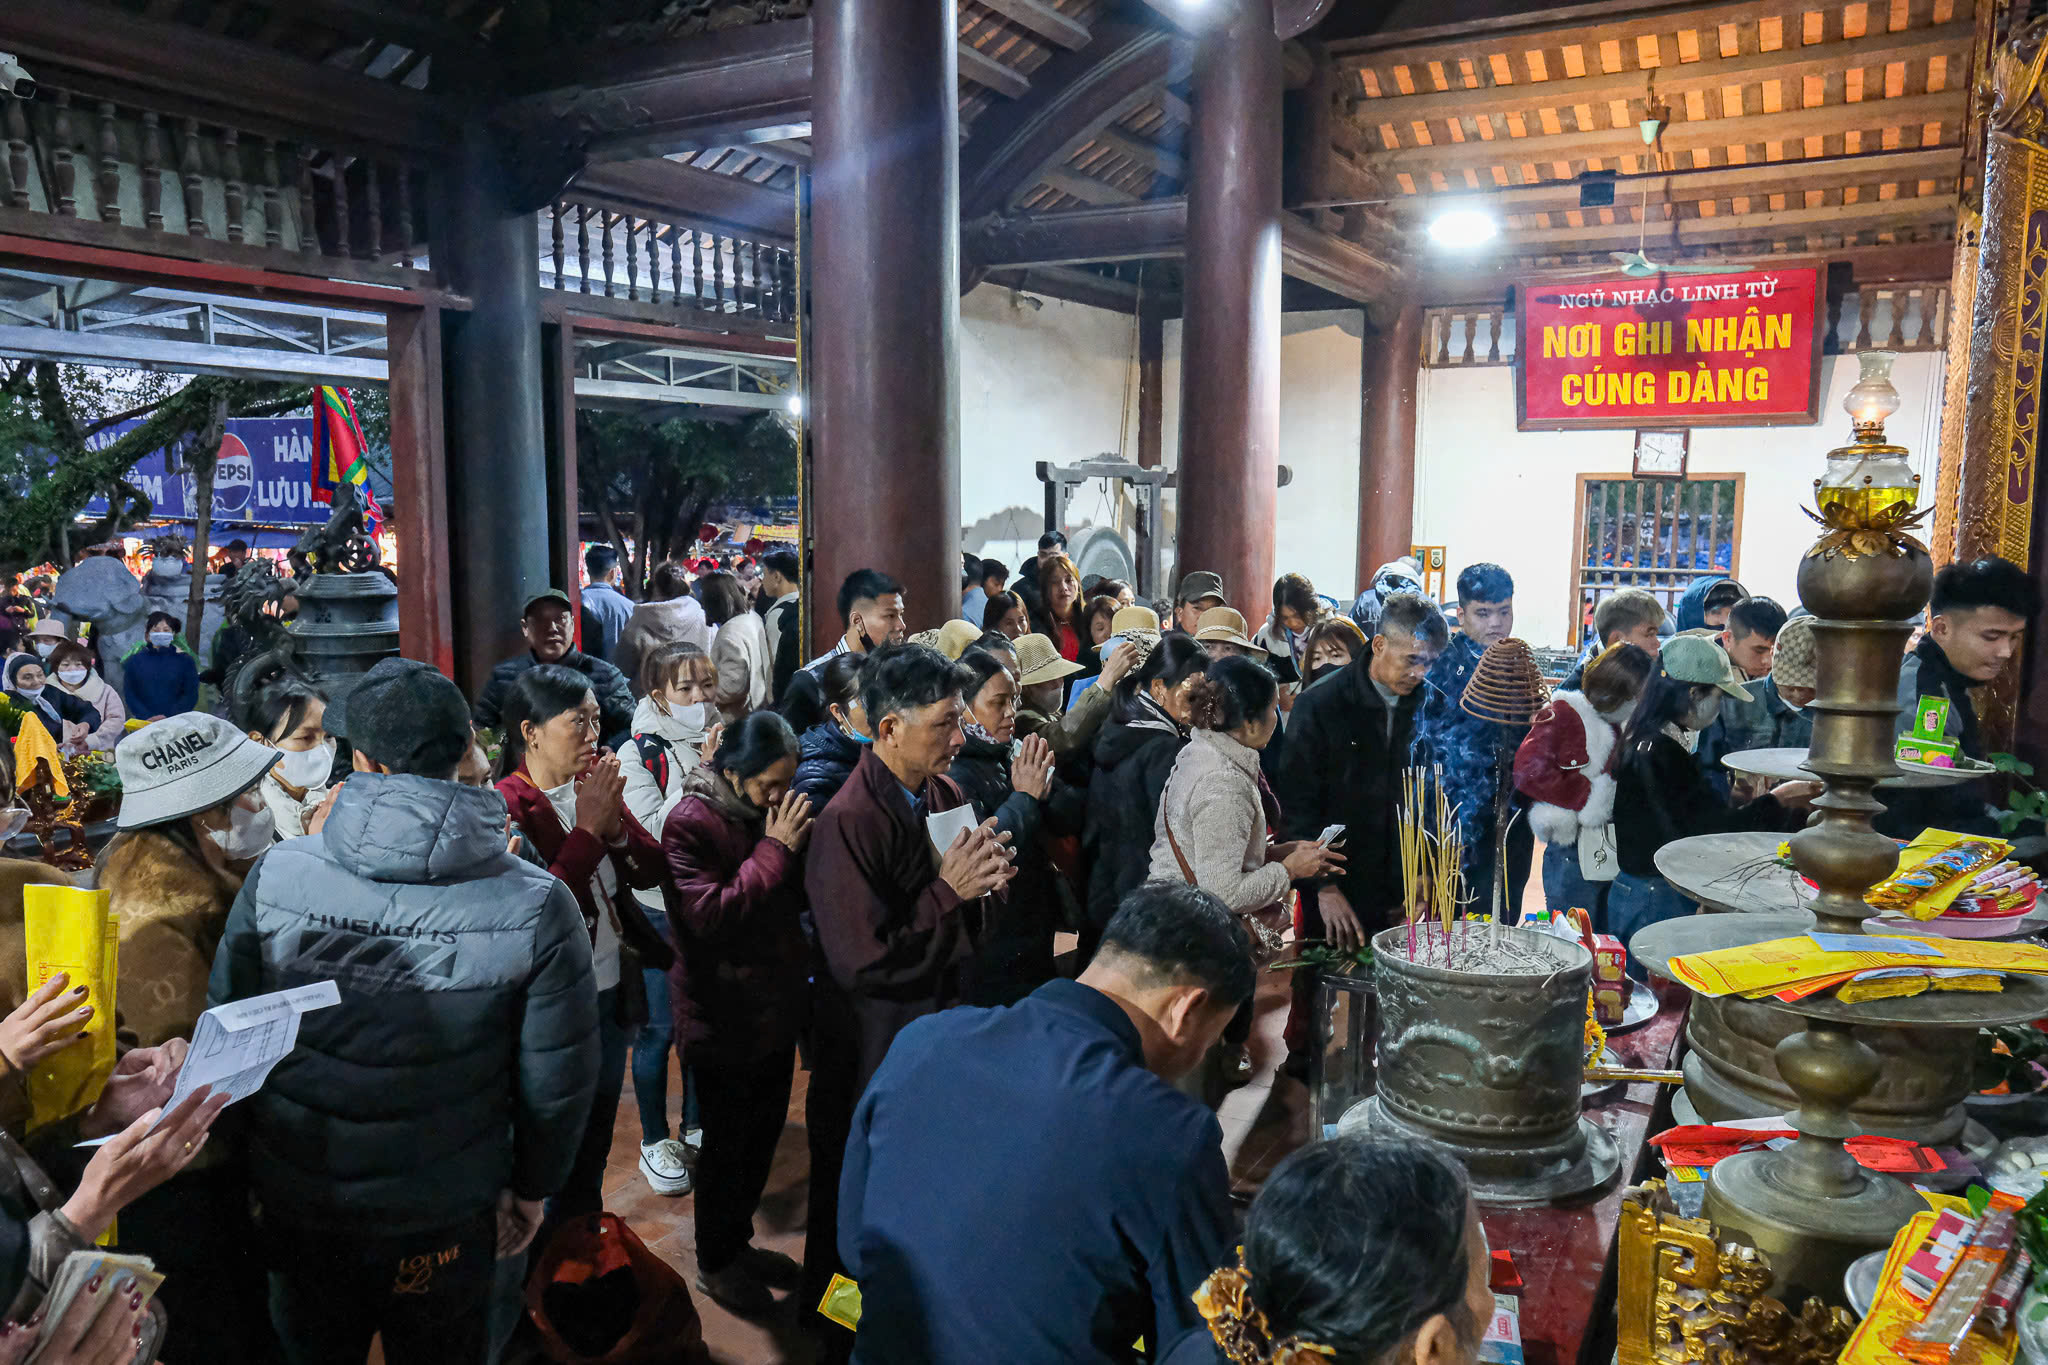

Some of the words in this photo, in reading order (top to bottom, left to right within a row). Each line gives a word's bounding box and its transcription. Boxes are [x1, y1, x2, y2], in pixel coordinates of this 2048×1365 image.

[1559, 289, 1604, 309] NGŨ
[1611, 287, 1674, 308] NHẠC
[1681, 283, 1739, 302] LINH
[1745, 275, 1778, 299] TỪ
[1543, 321, 1601, 359] NƠI
[1613, 320, 1672, 356] GHI
[1686, 305, 1792, 358] NHẬN
[1561, 365, 1656, 407] CÚNG
[1668, 361, 1769, 405] DÀNG
[214, 463, 251, 481] EPSI
[257, 476, 299, 508] LƯU
[141, 731, 213, 770] CHANEL
[167, 756, 199, 775] PARIS
